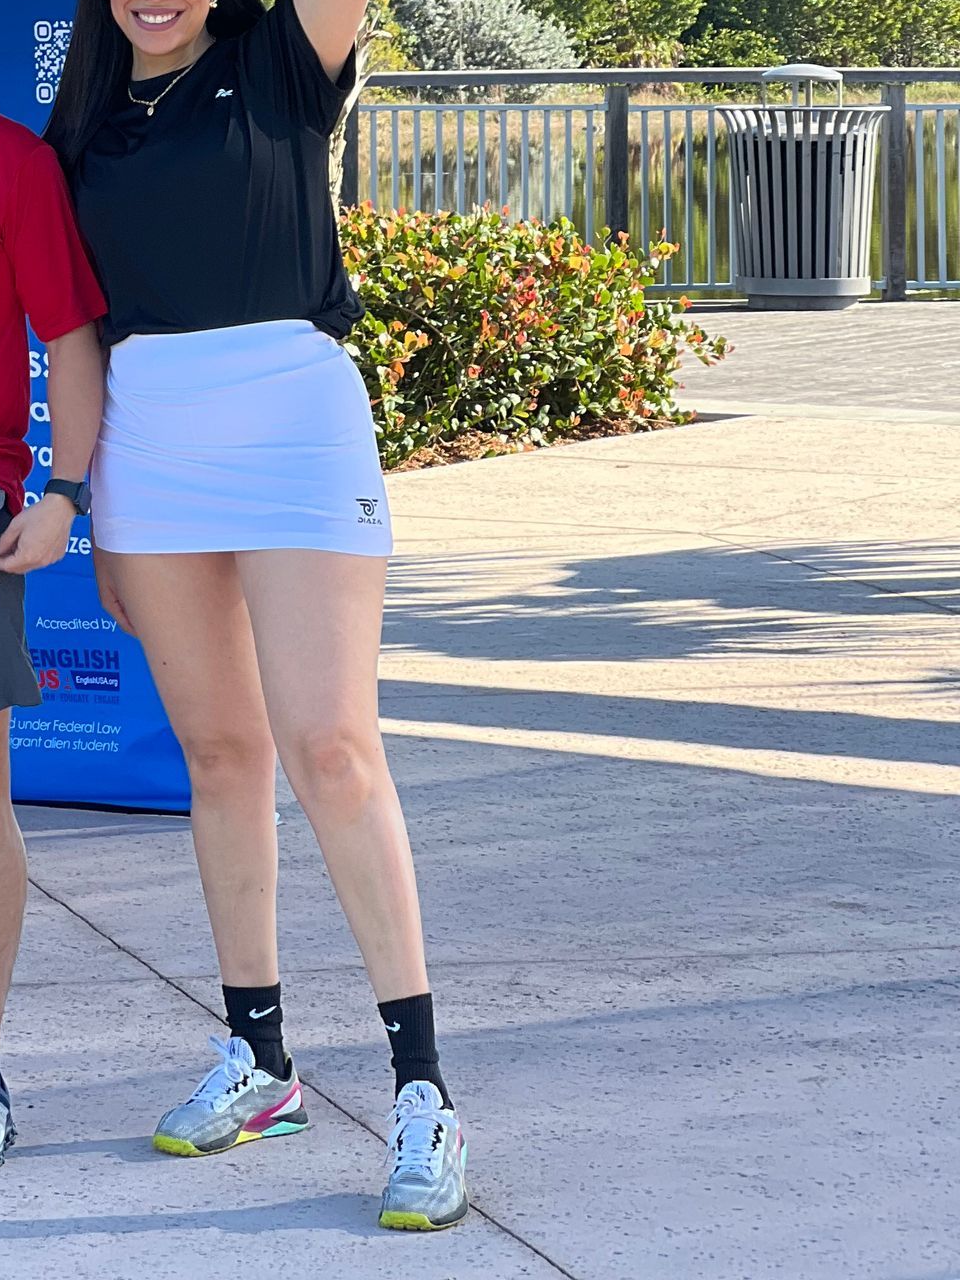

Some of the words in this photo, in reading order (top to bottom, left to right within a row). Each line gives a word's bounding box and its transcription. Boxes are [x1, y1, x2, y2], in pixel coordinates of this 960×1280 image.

[35, 616, 99, 629] Accredited
[101, 617, 117, 632] by
[31, 648, 120, 670] ENGLISH
[75, 675, 119, 687] EnglishUSA.org
[18, 719, 51, 731] under
[53, 720, 95, 734] Federal
[96, 722, 121, 735] Law
[43, 736, 71, 749] alien
[72, 738, 120, 753] students
